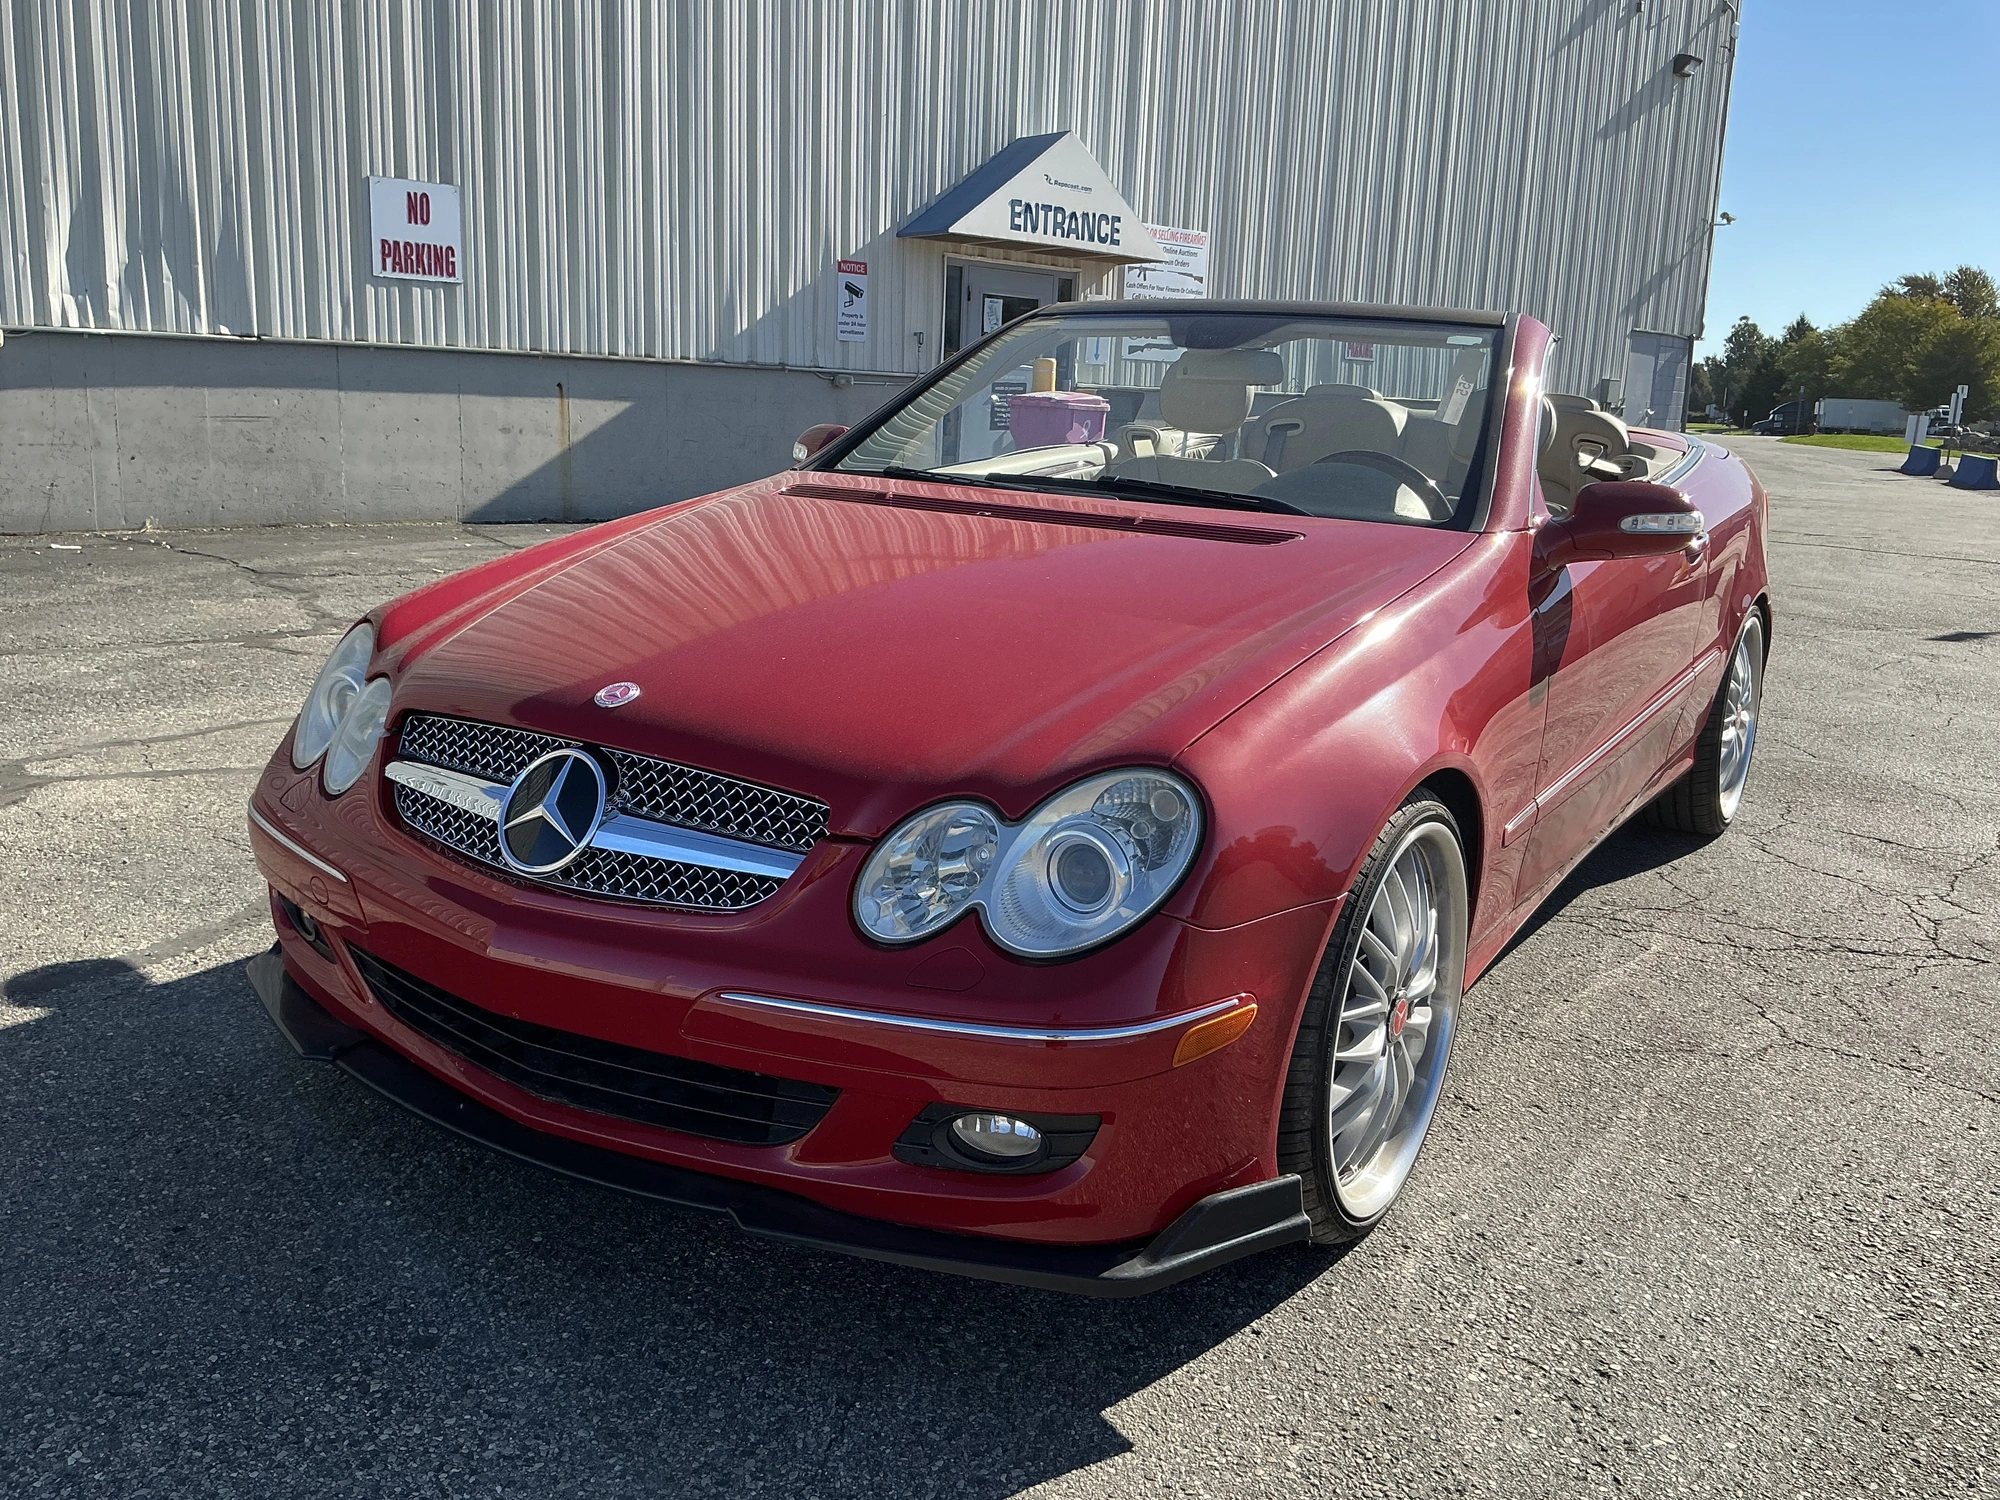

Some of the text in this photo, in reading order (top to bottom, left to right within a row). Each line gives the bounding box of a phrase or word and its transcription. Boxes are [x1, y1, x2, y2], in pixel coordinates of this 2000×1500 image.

[406, 191, 431, 226] NO
[1009, 199, 1121, 246] ENTRANCE
[1158, 229, 1179, 242] SELLING
[1180, 232, 1206, 246] FIREARMS?
[381, 239, 457, 278] PARKING
[1163, 246, 1198, 257] Online Auctions
[841, 262, 865, 273] NOTICE
[1174, 259, 1190, 267] Orders
